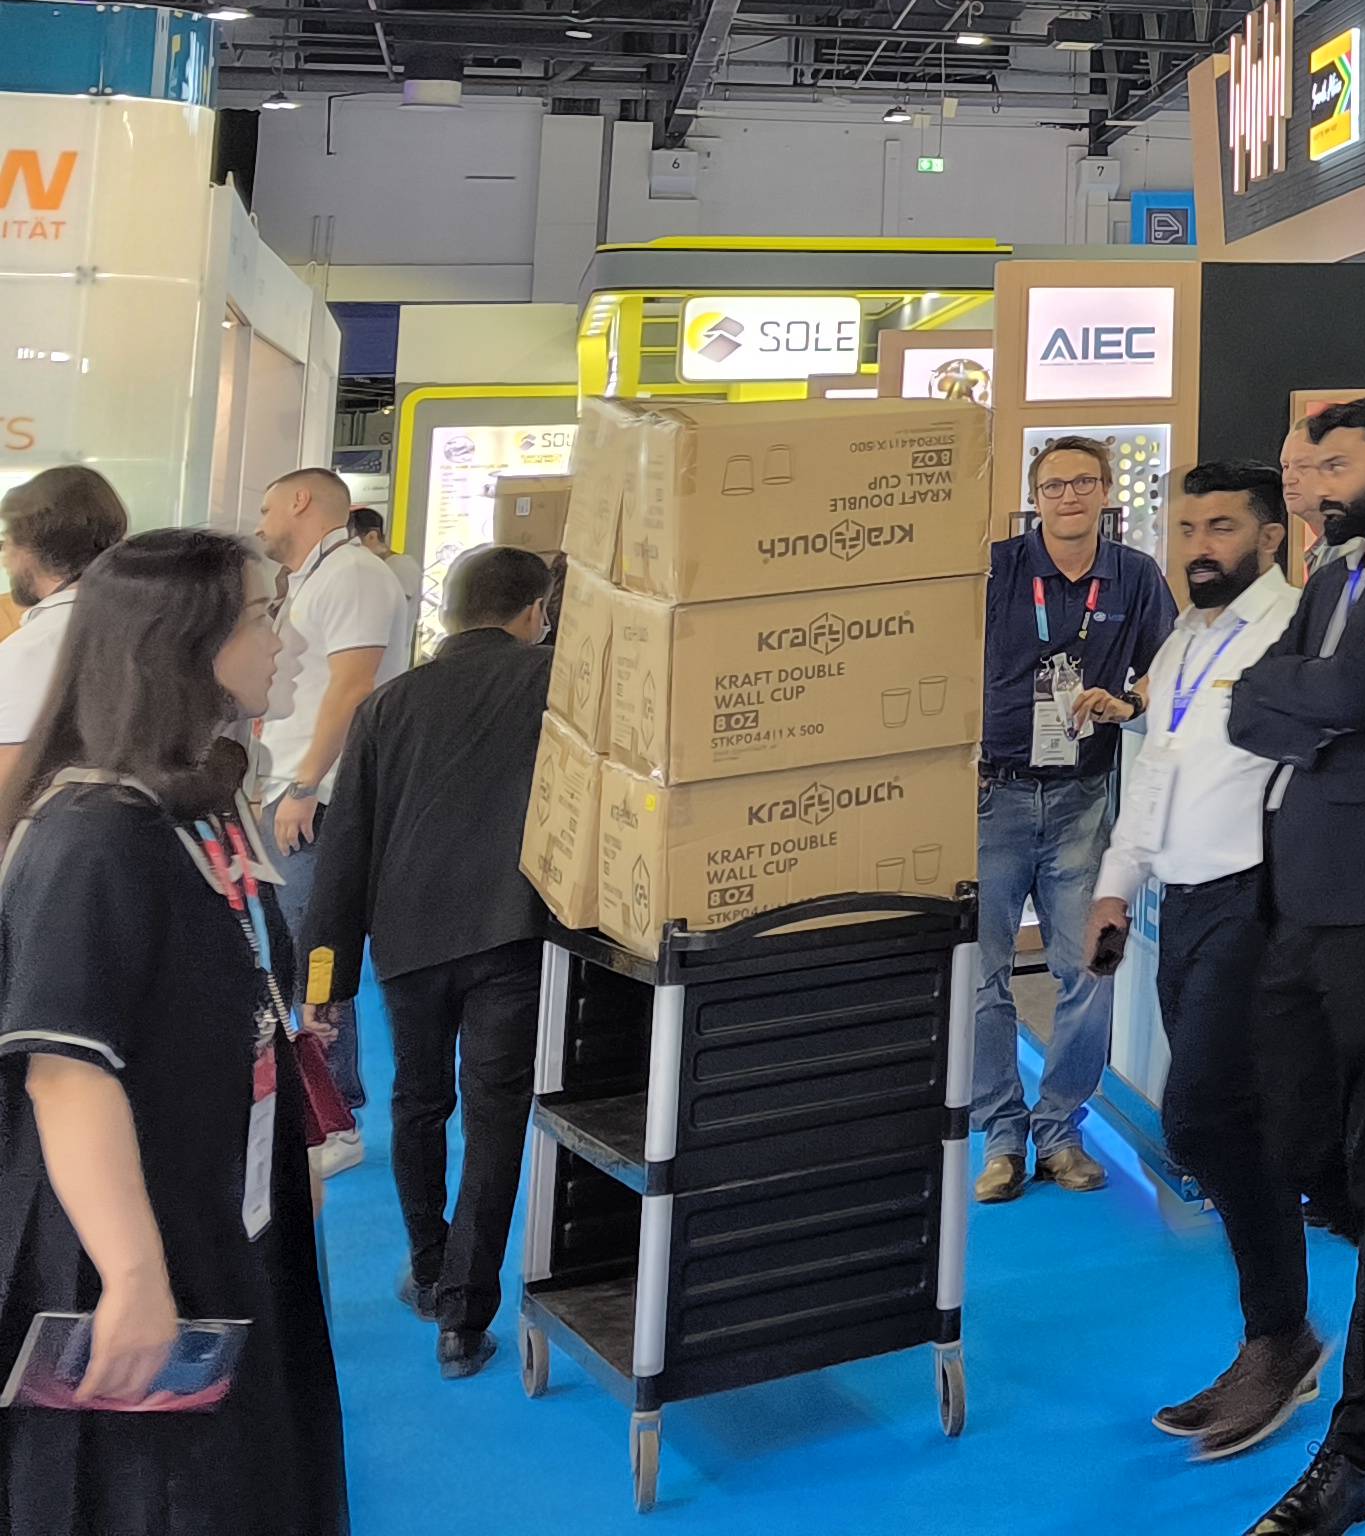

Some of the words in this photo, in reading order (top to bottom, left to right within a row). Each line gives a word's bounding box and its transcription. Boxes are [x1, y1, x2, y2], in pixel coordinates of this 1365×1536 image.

[672, 158, 680, 169] 6
[758, 320, 857, 353] SOLE
[1040, 327, 1156, 361] AIEC
[0, 416, 35, 451] S
[913, 452, 938, 466] OZ
[868, 475, 901, 490] CUP
[906, 471, 952, 486] WALL
[829, 494, 895, 512] DOUBLE
[898, 488, 953, 506] KRAFT
[715, 670, 773, 691] KRAFT
[778, 662, 846, 683] DOUBLE
[715, 690, 765, 710] WALL
[771, 685, 805, 703] CUP
[715, 716, 726, 732] 8
[734, 712, 758, 730] OZ
[800, 723, 825, 737] 500
[707, 844, 765, 866] KRAFT
[771, 832, 838, 856] DOUBLE
[706, 864, 757, 885] WALL
[764, 858, 798, 876] CUP
[710, 890, 720, 907] 8
[725, 885, 752, 905] OZ
